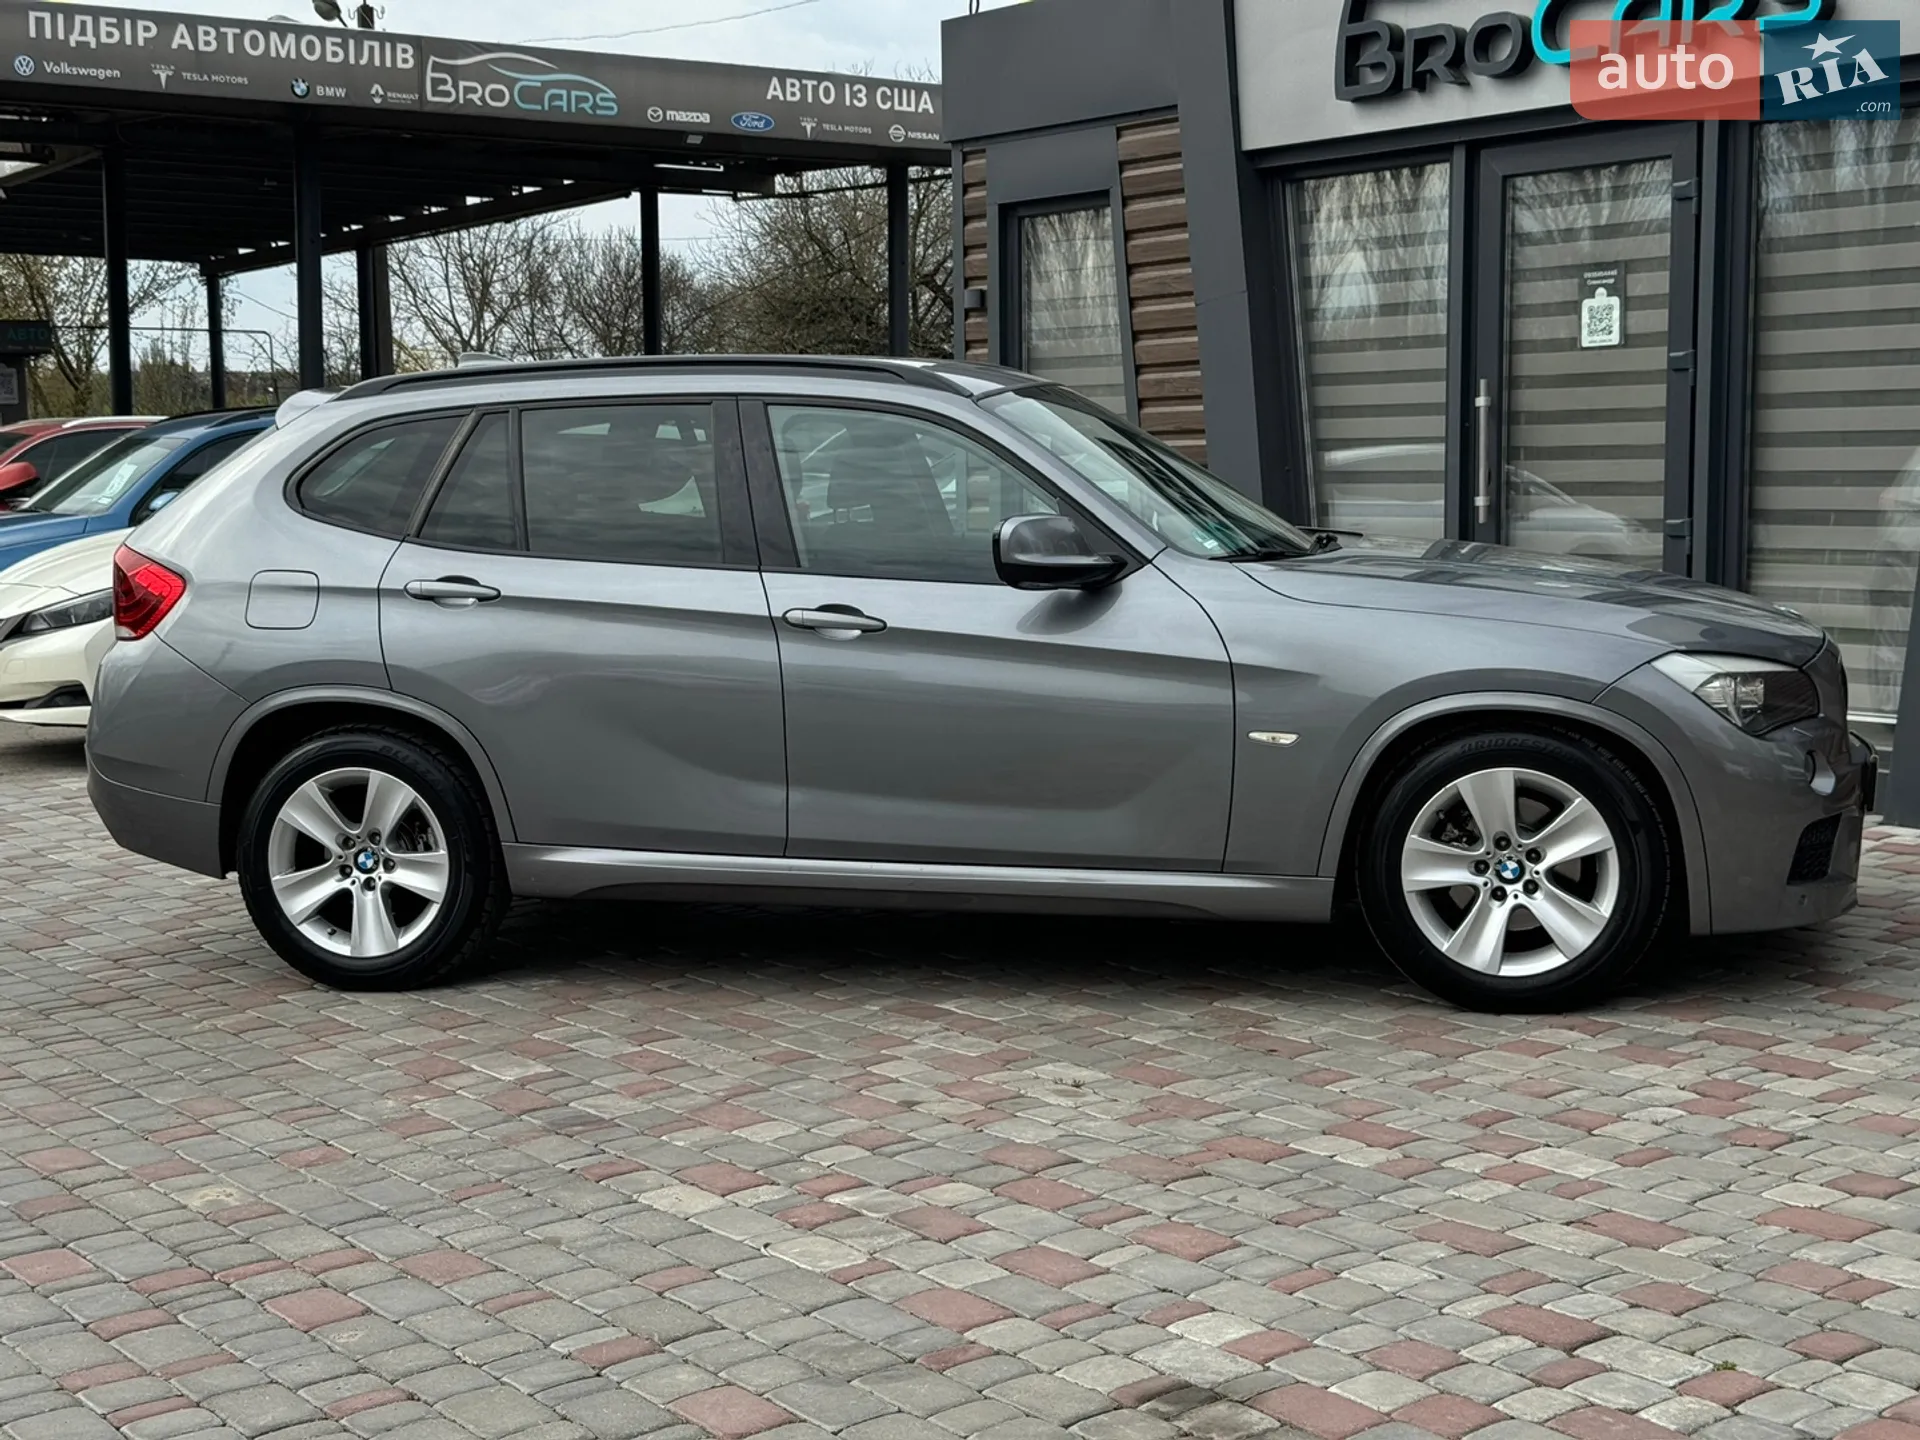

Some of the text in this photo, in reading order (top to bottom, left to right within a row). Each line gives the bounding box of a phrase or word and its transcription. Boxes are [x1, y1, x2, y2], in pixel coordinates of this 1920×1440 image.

[28, 10, 415, 69] ПІДБІР АВТОМОБІЛІВ
[42, 60, 121, 80] Volkswagen
[181, 71, 249, 85] TESLA MOTORS
[316, 85, 346, 98] BMW
[387, 91, 419, 100] RENAULT
[766, 76, 935, 115] АВТО ІЗ США
[666, 110, 710, 123] mazda
[740, 115, 765, 128] Ford
[822, 123, 872, 134] TESLA MOTORS
[907, 131, 940, 141] NISSAN
